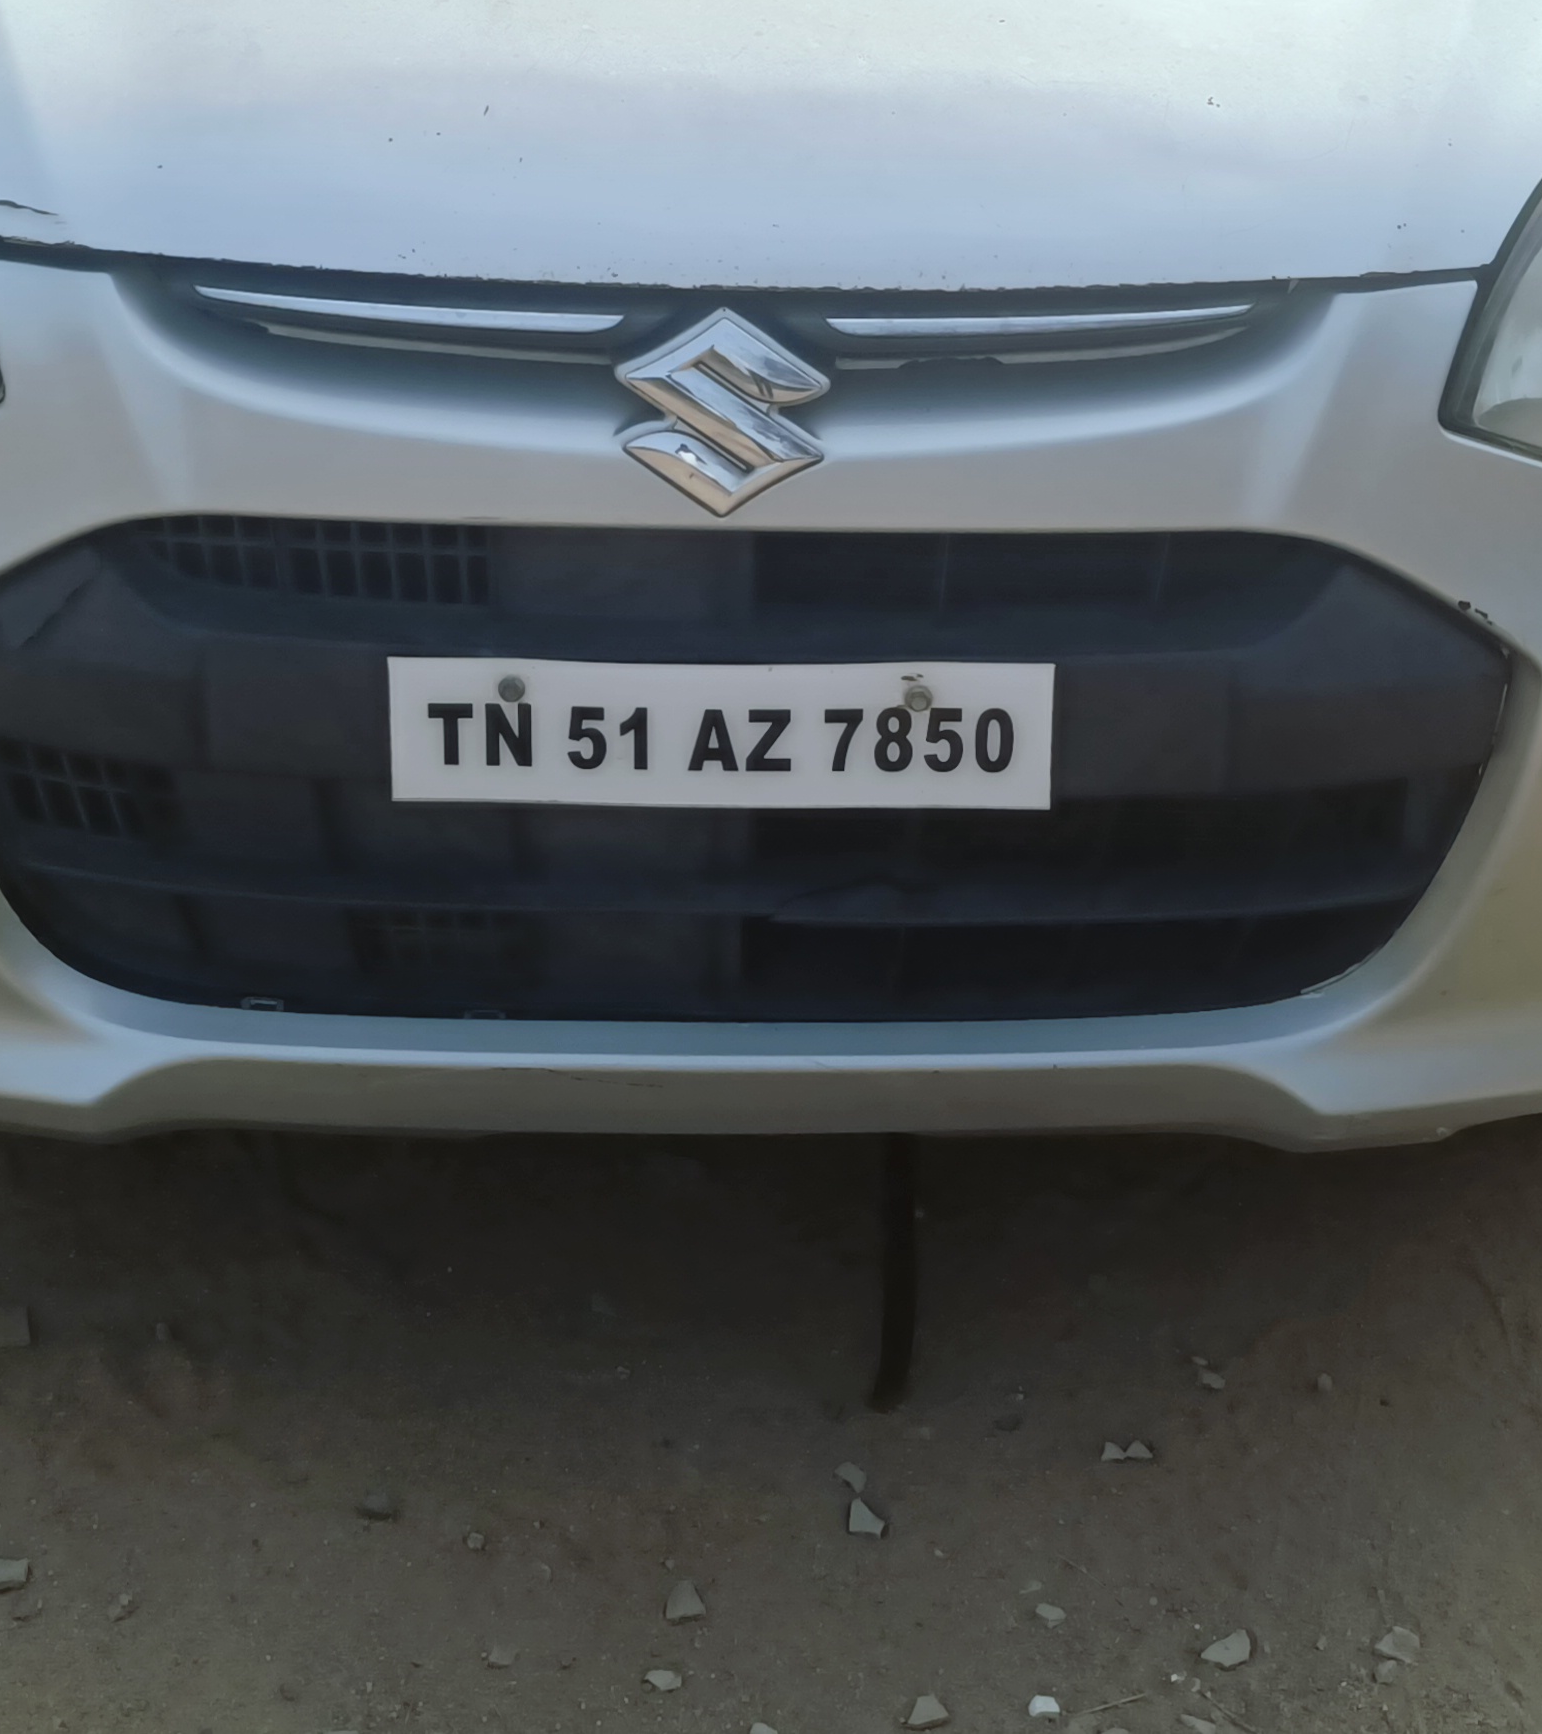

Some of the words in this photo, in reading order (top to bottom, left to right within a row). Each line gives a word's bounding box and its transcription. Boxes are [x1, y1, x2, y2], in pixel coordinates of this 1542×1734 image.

[428, 703, 532, 767] TN
[567, 706, 648, 770] 51
[688, 709, 792, 772] AZ
[824, 708, 1015, 773] 7850
